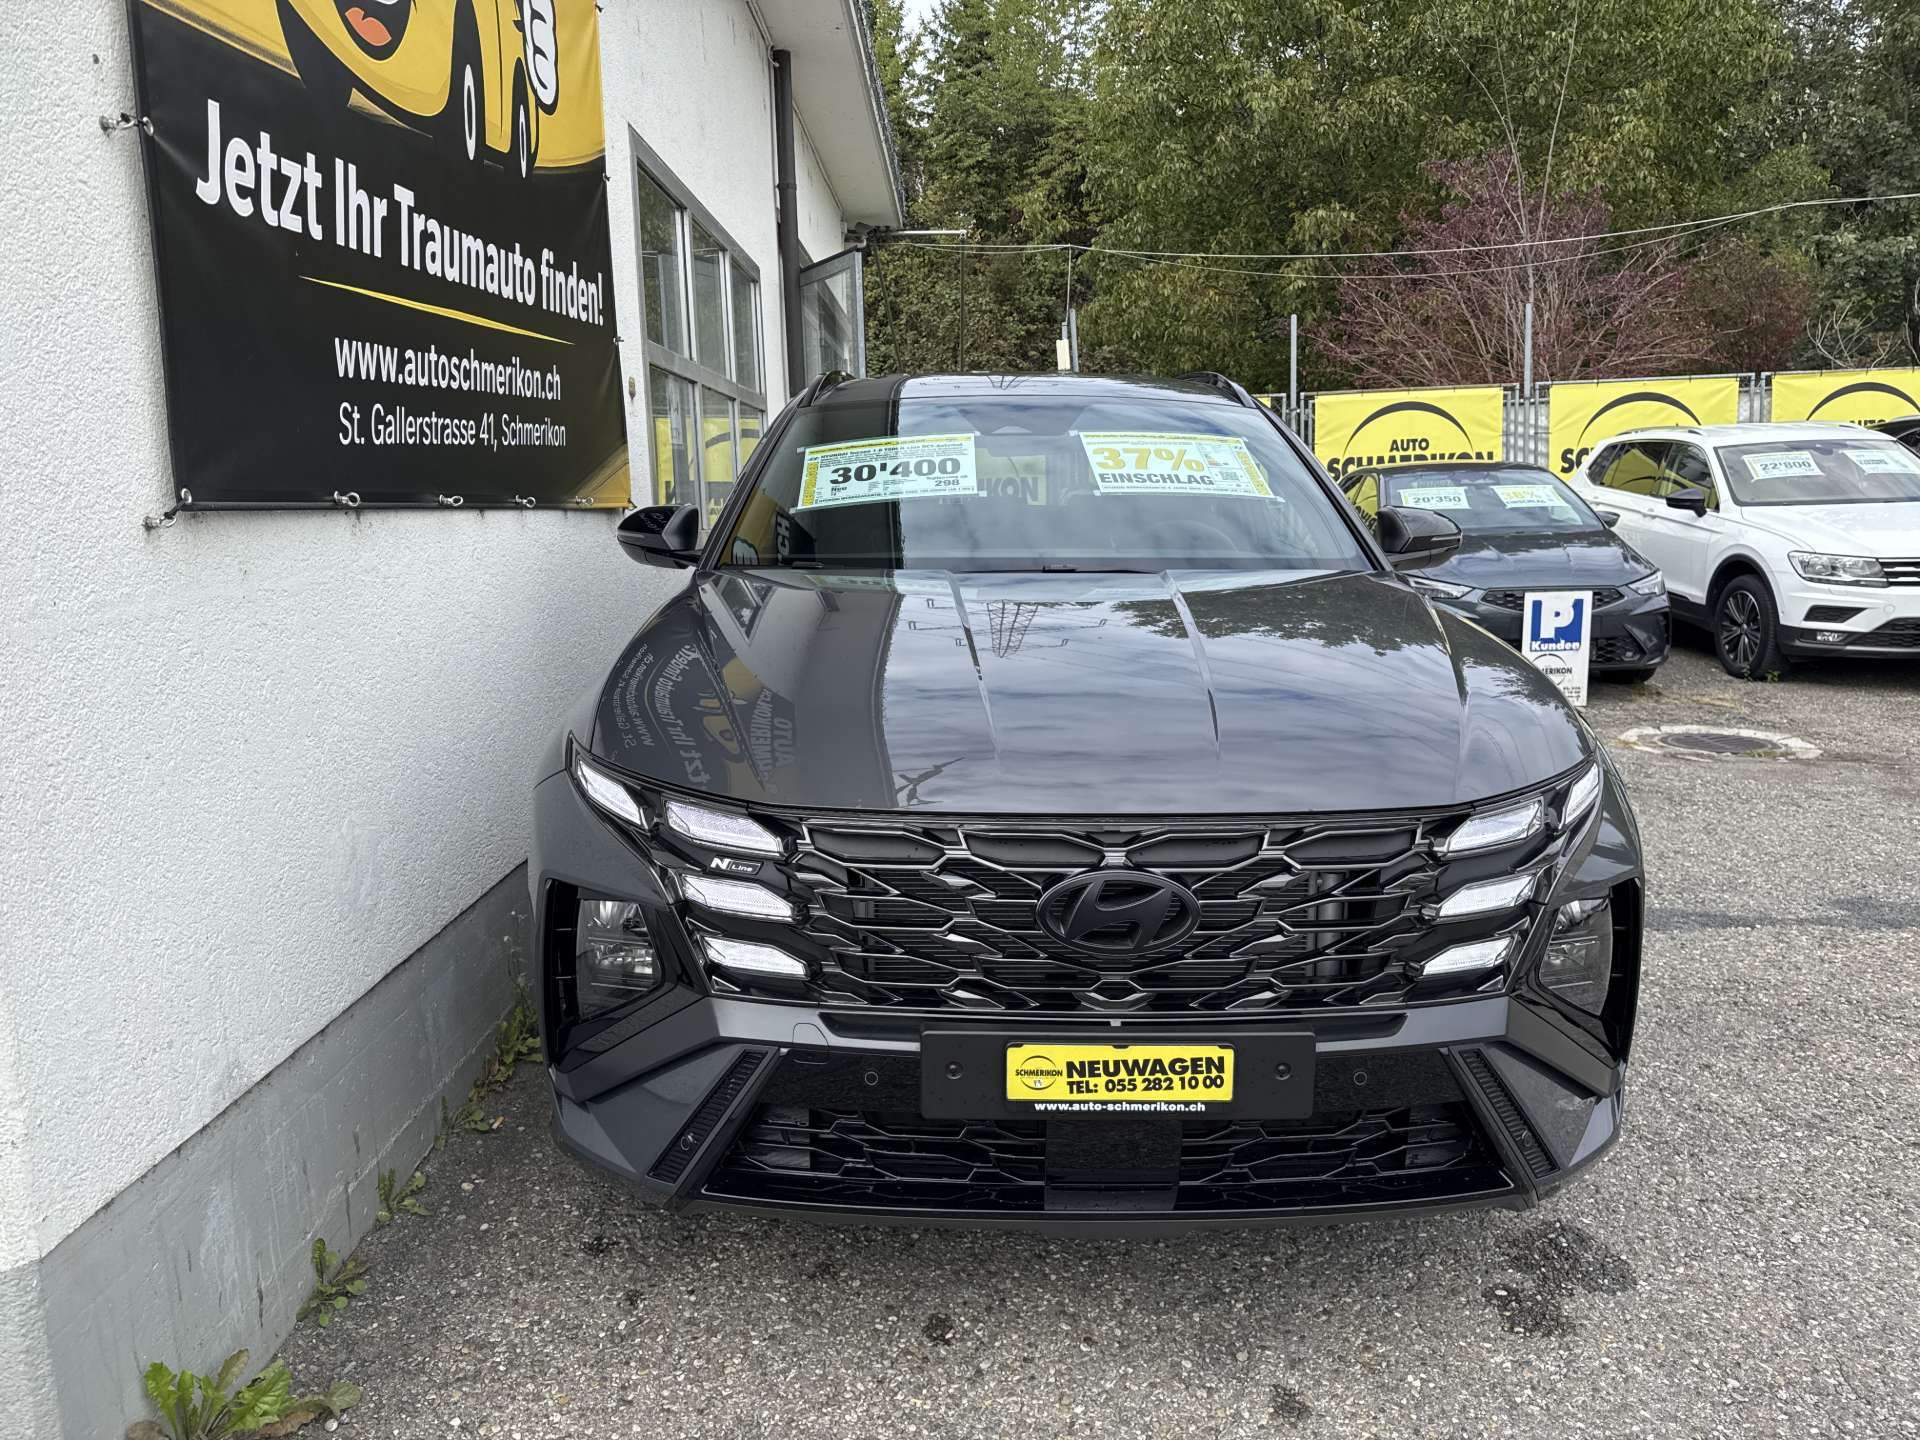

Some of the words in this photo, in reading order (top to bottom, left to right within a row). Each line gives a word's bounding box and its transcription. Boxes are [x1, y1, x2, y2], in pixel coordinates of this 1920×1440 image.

[195, 98, 323, 241] Jetzt
[335, 156, 388, 260] Ihr
[393, 183, 536, 306] Traumauto
[540, 247, 604, 327] finden!
[334, 336, 561, 401] www.autoschmerikon.ch
[338, 401, 365, 446] St.
[370, 403, 476, 446] Gallerstrasse
[479, 412, 498, 452] 41,
[500, 413, 566, 447] Schmerikon
[1389, 437, 1430, 453] AUTO
[1091, 447, 1205, 472] 37%
[1759, 460, 1812, 471] 22'800
[829, 457, 961, 485] 30'400
[1100, 473, 1215, 486] EINSCHLAG
[1413, 495, 1462, 504] 20'350
[1540, 599, 1575, 639] P
[1531, 639, 1581, 651] Kunden
[1542, 667, 1573, 675] ERIKON
[710, 857, 731, 870] N
[731, 864, 753, 872] Line
[1015, 1068, 1063, 1077] SCHMERIKON
[1065, 1056, 1225, 1079] NEUWAGEN
[1067, 1081, 1099, 1094] TEL:
[1104, 1078, 1137, 1093] 055
[1141, 1077, 1174, 1092] 282
[1178, 1076, 1199, 1090] 10
[1202, 1075, 1225, 1089] 00
[1034, 1101, 1206, 1112] www.auto-schmerikon.ch
